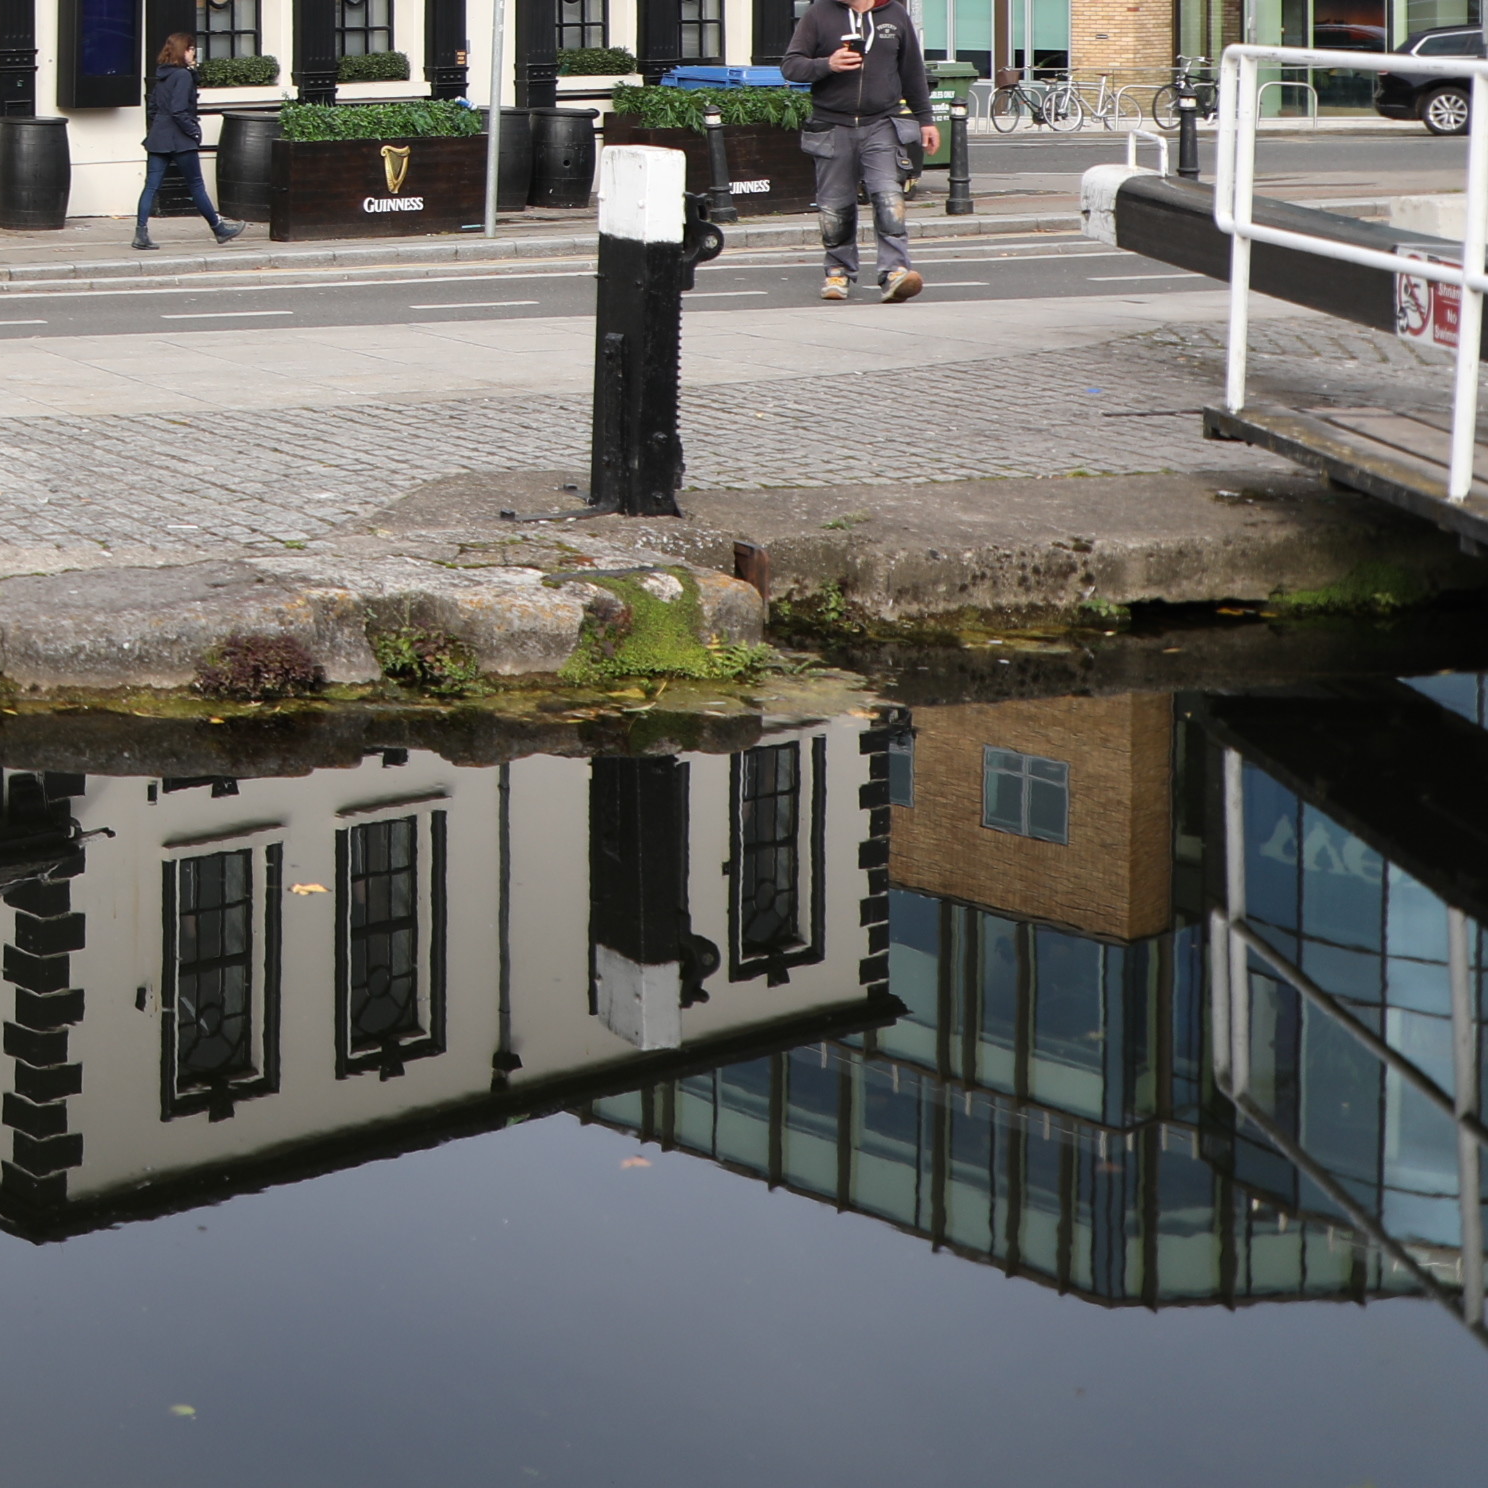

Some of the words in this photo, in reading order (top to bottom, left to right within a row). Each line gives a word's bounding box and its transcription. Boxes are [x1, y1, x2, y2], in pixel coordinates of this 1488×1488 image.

[932, 102, 949, 110] anda
[729, 179, 770, 194] UINNESS
[363, 197, 424, 213] GUINNESS
[1447, 309, 1457, 324] No
[1435, 324, 1460, 341] Swimm
